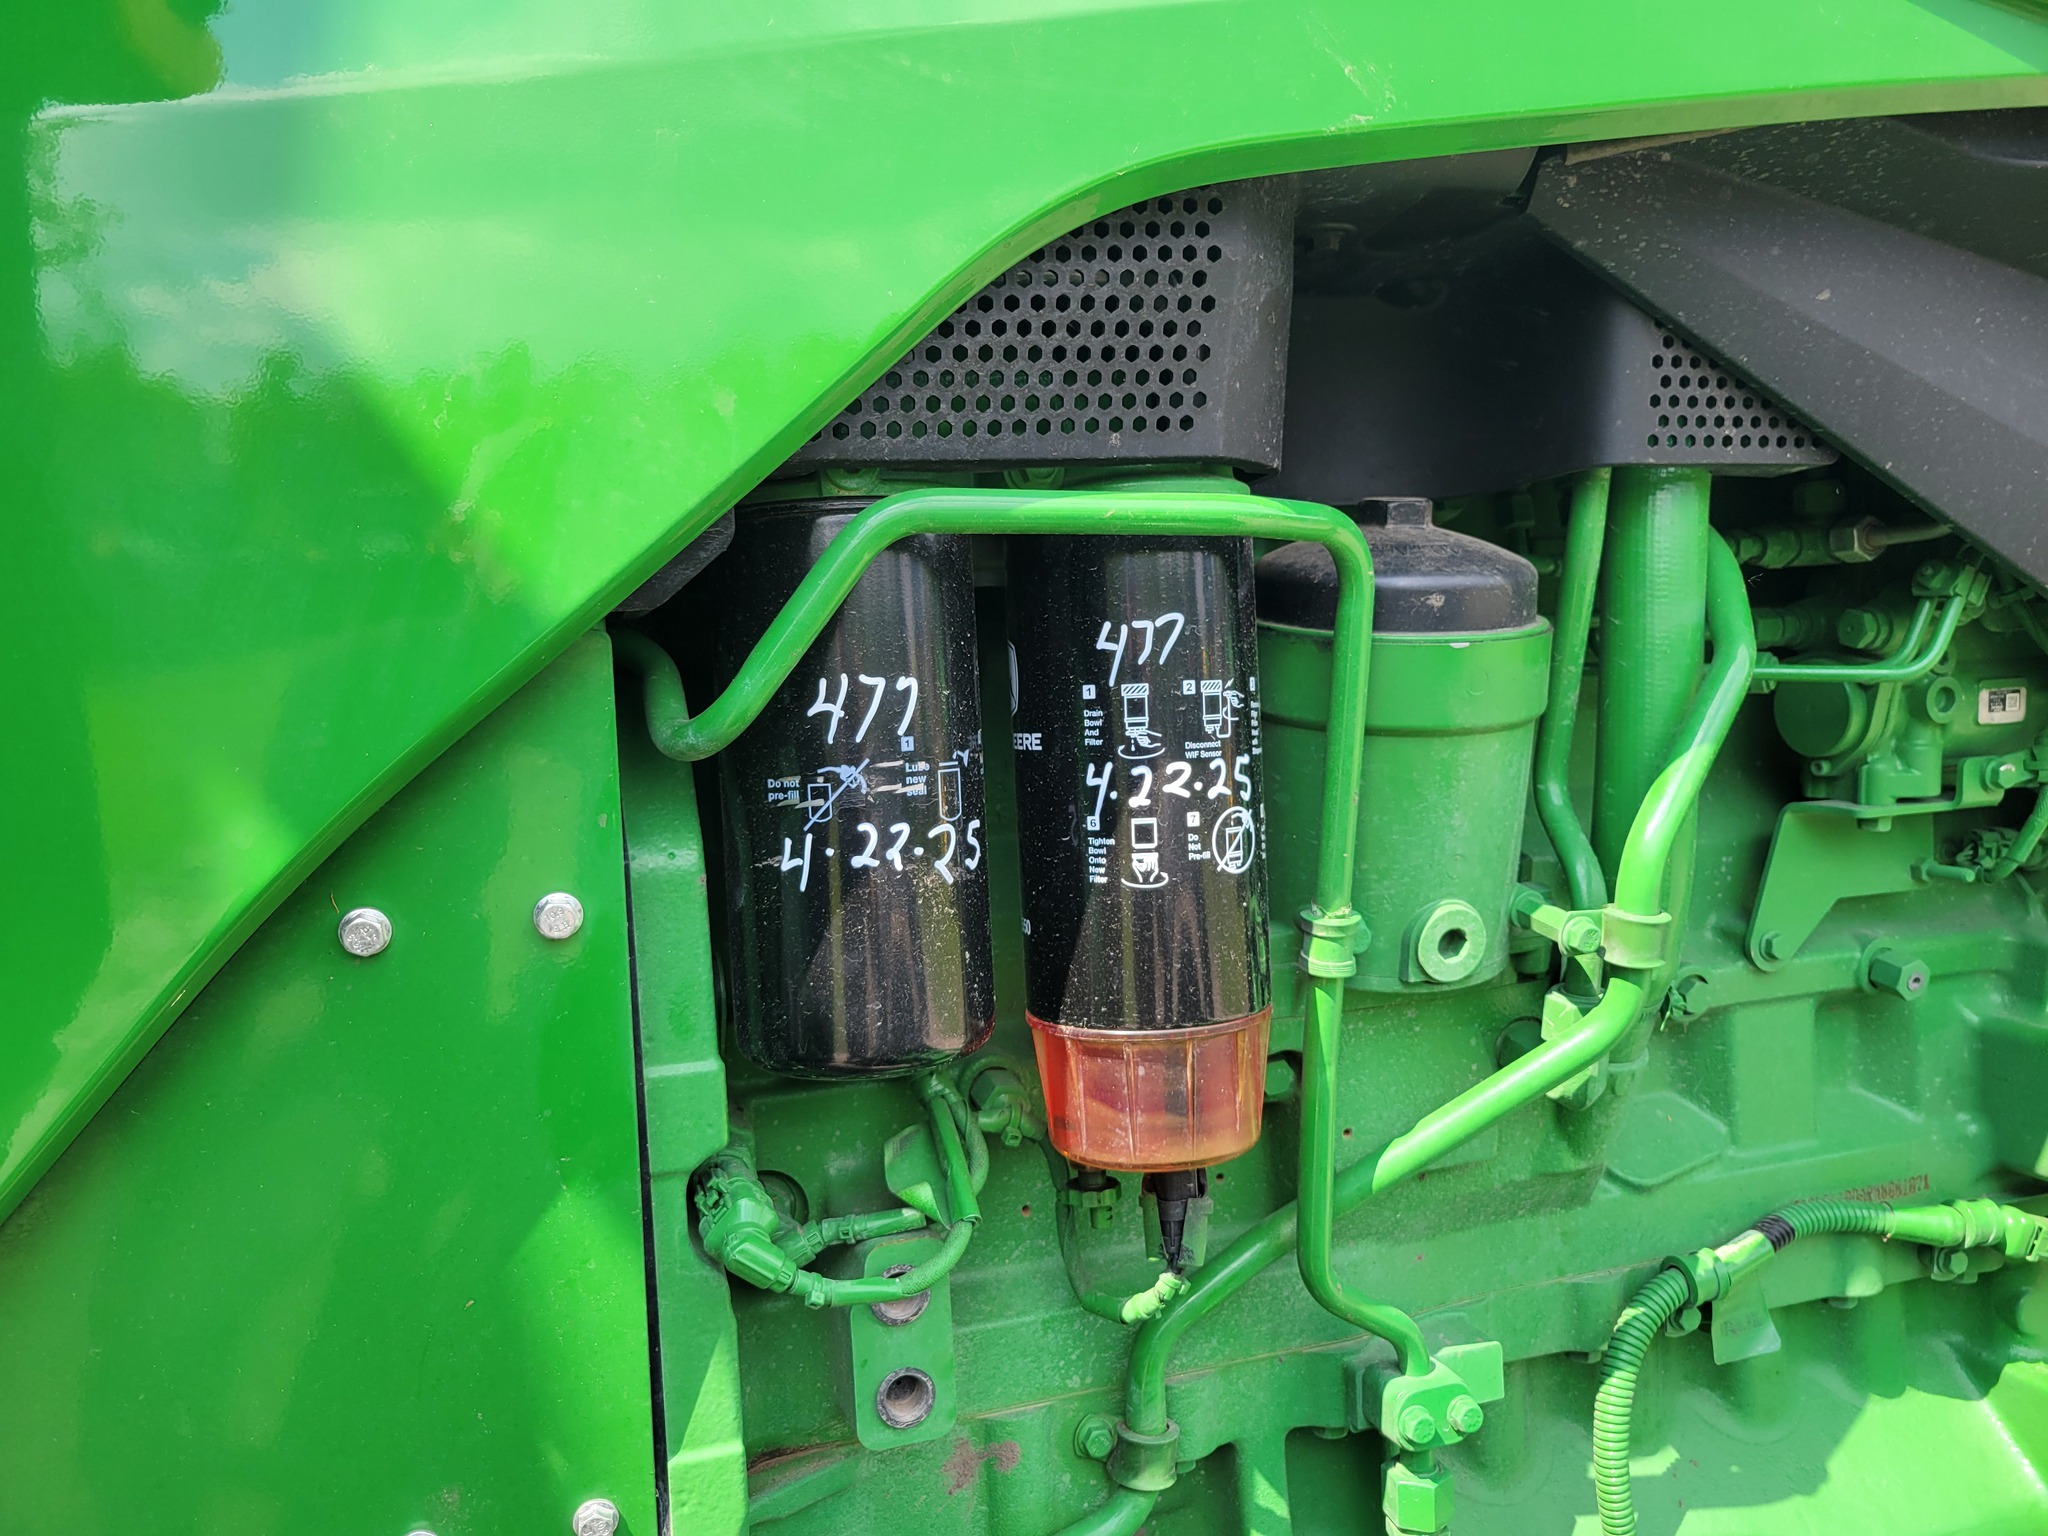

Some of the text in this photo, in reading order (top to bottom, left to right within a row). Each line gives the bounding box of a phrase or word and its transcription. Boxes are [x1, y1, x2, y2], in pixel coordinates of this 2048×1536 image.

[1096, 612, 1185, 687] 477
[807, 673, 918, 744] 477
[1083, 709, 1104, 718] Drain
[1084, 718, 1104, 727] Bowl
[1084, 728, 1100, 737] And
[1085, 738, 1104, 746] Filter
[1184, 740, 1222, 750] Disconnect
[1184, 749, 1223, 760] WIF Sensor
[767, 778, 801, 789] Do not
[905, 775, 927, 785] new
[767, 789, 800, 802] pre-fill
[1087, 837, 1116, 847] Tighten
[1187, 833, 1200, 842] Do
[1088, 846, 1107, 855] Bowl
[1187, 842, 1202, 852] Not
[1088, 856, 1107, 865] Onto
[1088, 865, 1106, 875] New
[1089, 875, 1109, 884] Filter
